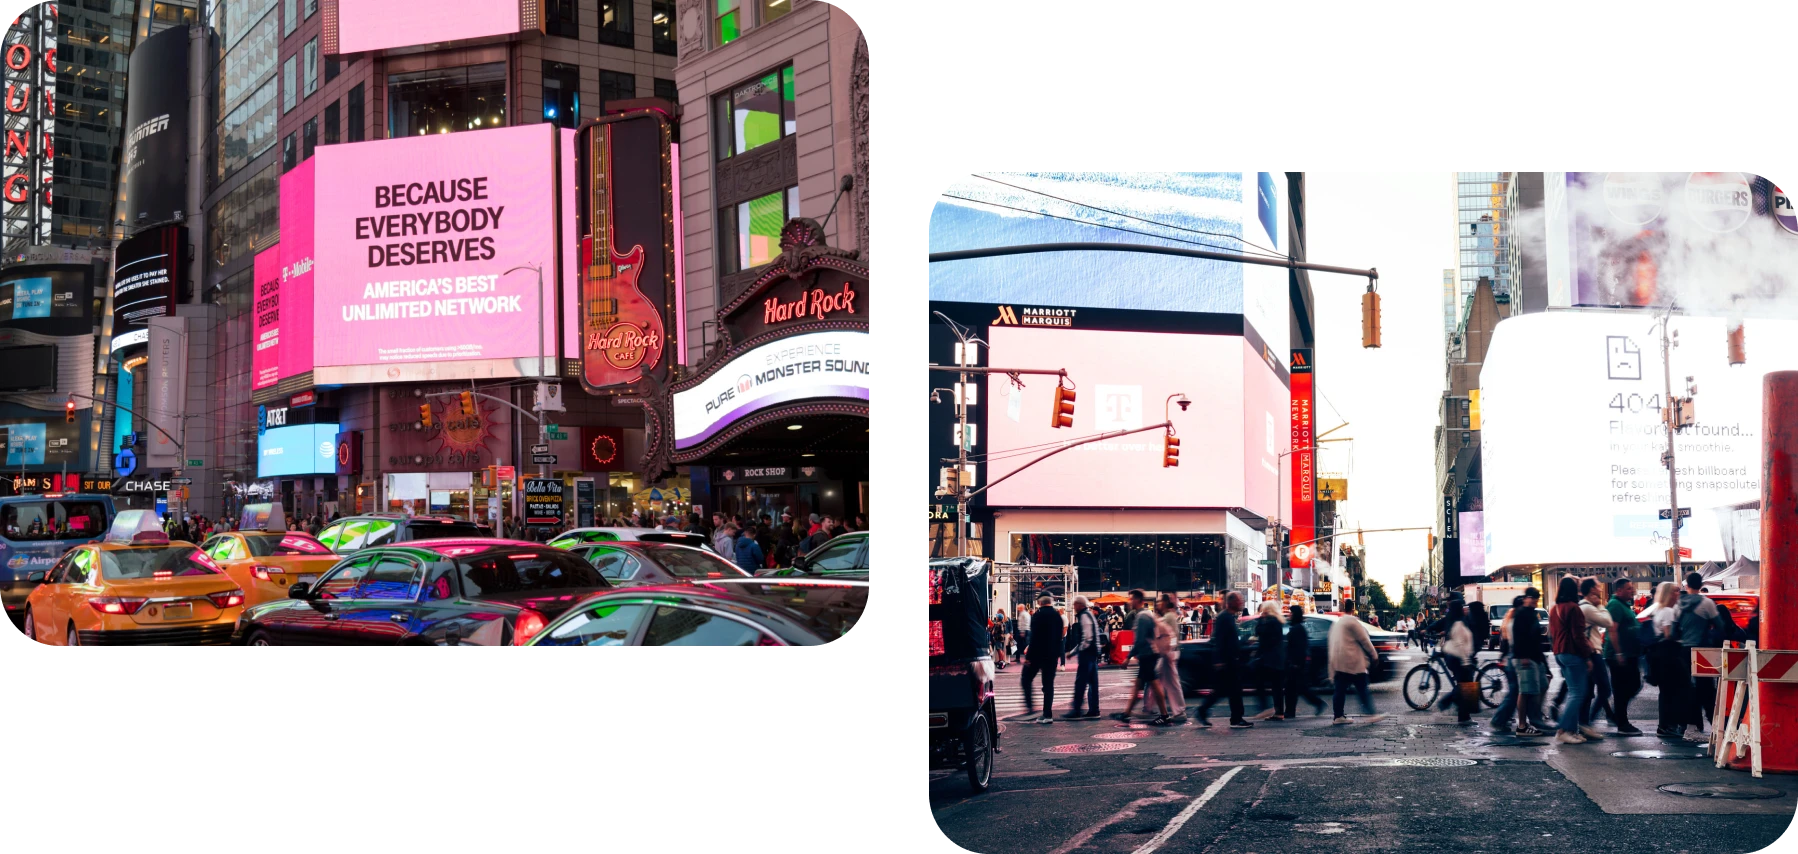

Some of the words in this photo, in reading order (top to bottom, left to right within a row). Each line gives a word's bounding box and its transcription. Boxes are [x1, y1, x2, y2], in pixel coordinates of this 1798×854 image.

[4, 14, 31, 203] OUNG
[375, 176, 488, 208] BECAUSE
[355, 206, 504, 240] EVERYBODY
[368, 236, 496, 268] DESERVES
[363, 276, 452, 300] AMERICA’S
[455, 274, 498, 294] BEST
[342, 300, 432, 322] UNLIMITED
[434, 295, 522, 317] NETWORK
[764, 290, 808, 324] Hard
[810, 282, 855, 320] Rock
[1023, 307, 1076, 317] MARRIOTT
[1023, 317, 1070, 326] MARQUIS
[588, 332, 624, 350] Hard
[624, 330, 658, 350] Rock
[765, 344, 841, 366] EXPERIENCE
[705, 386, 735, 414] PURE
[755, 360, 821, 386] MONSTER
[1609, 393, 1661, 414] 404
[266, 407, 288, 427] AT&T
[1609, 421, 1660, 436] Flavor
[1083, 442, 1120, 451] better
[1122, 443, 1146, 452] over
[1149, 442, 1165, 452] he
[1610, 442, 1620, 451] in
[1622, 443, 1648, 454] your
[1652, 442, 1670, 451] kal
[1678, 443, 1734, 452] smoothie.
[745, 468, 764, 477] ROCK
[766, 467, 786, 476] SHOP
[1302, 454, 1310, 500] MARQUIS
[1698, 466, 1746, 476] billboard
[98, 481, 110, 490] OUR
[126, 481, 170, 491] CHASE
[526, 481, 546, 492] Bella
[547, 482, 562, 492] Vita
[1612, 479, 1628, 488] for
[1299, 548, 1306, 557] P
[1565, 565, 1660, 578] AMERICAN
